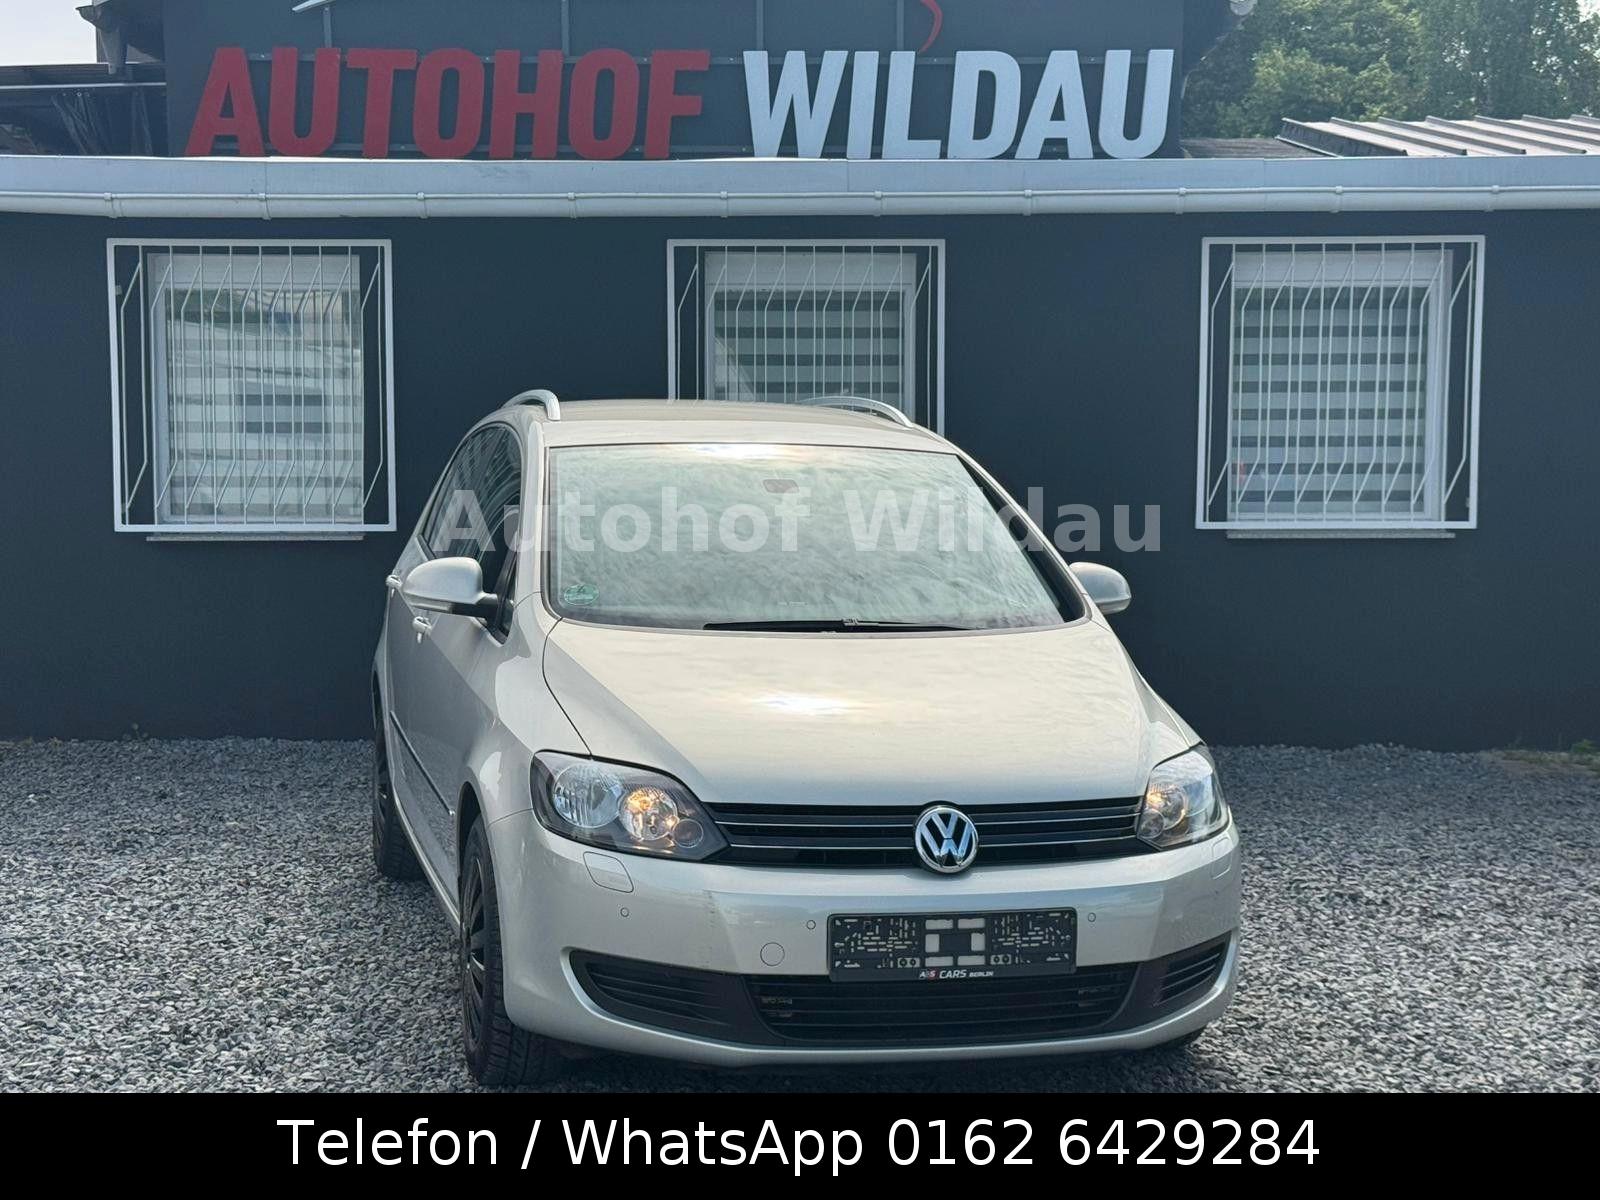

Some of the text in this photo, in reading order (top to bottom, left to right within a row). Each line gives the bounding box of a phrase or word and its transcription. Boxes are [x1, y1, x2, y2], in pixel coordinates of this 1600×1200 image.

[185, 47, 1174, 159] AUTOHOF WILDAU
[939, 969, 967, 979] CARS
